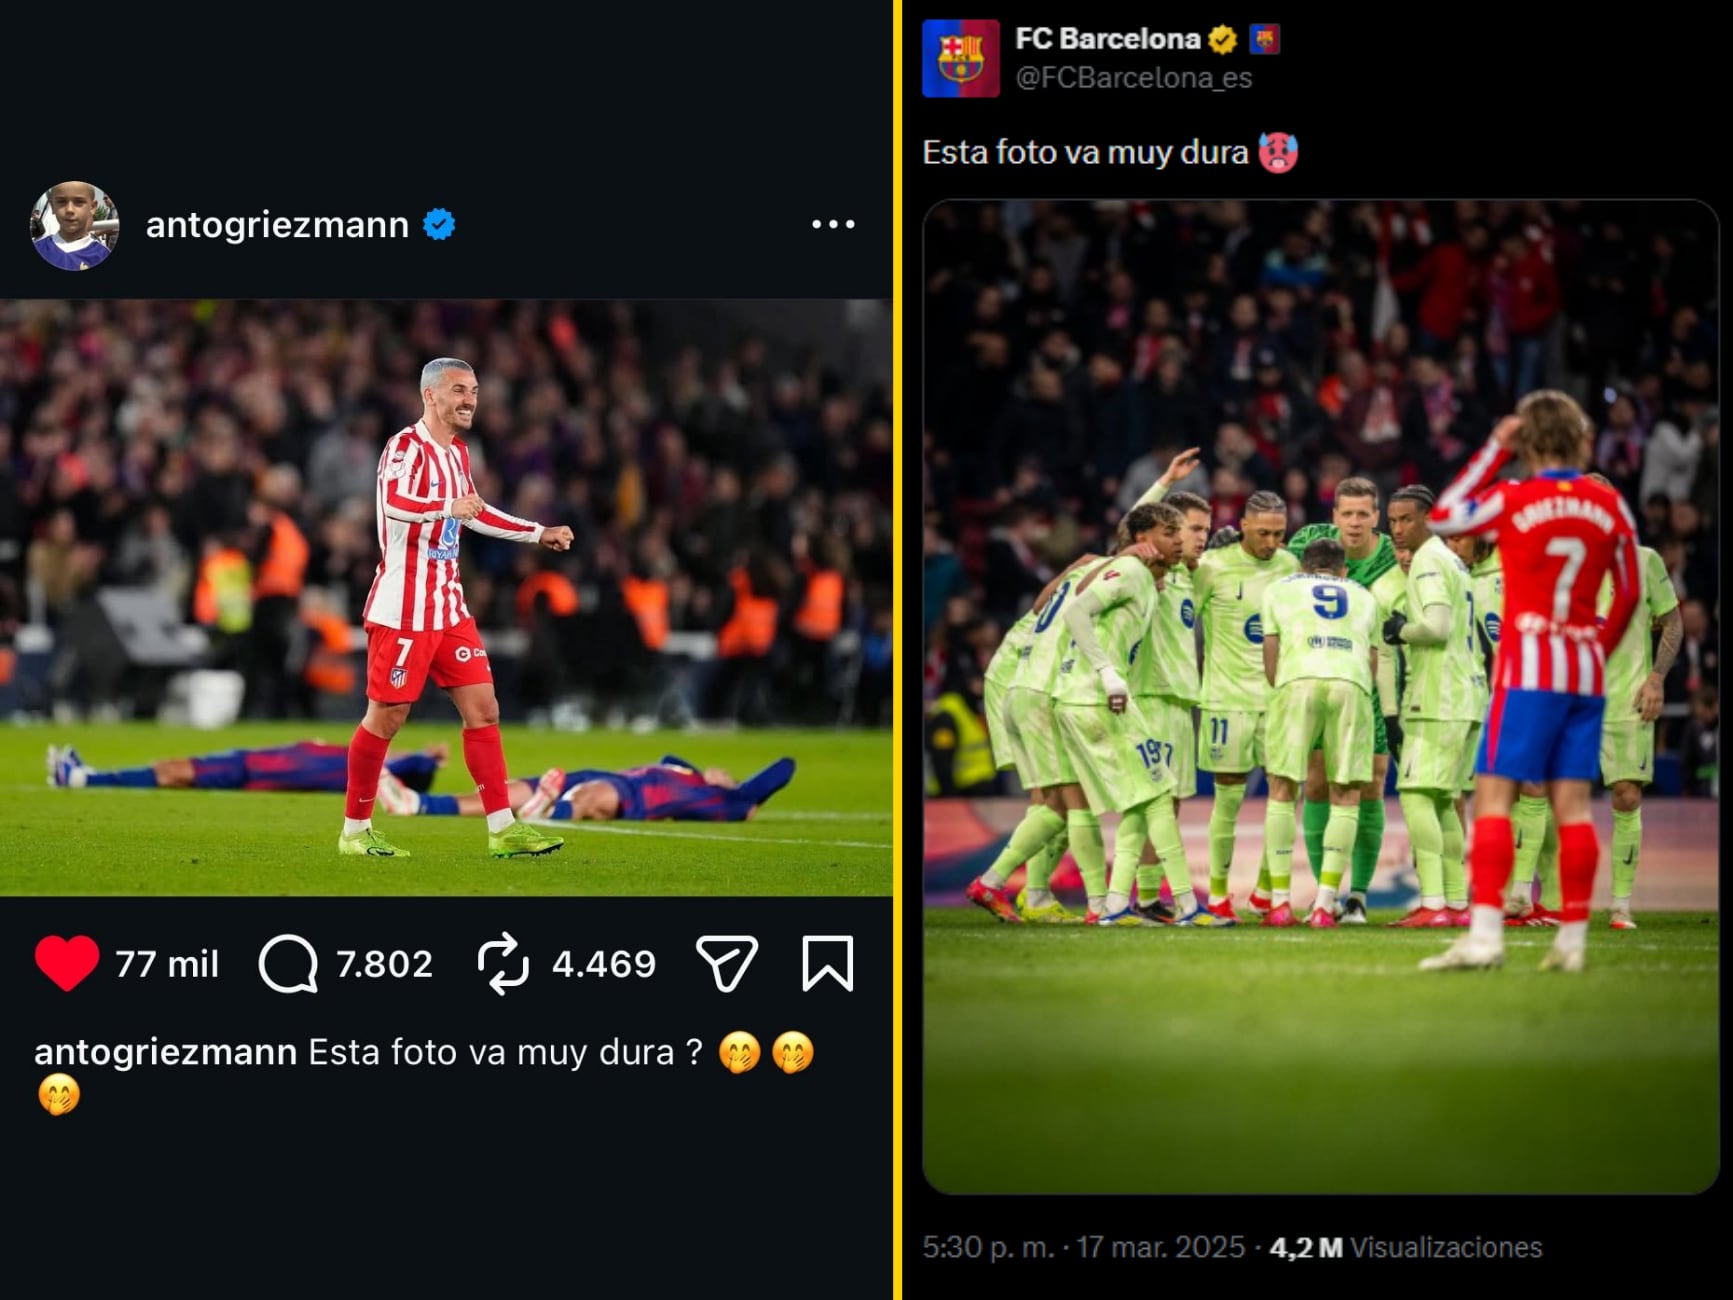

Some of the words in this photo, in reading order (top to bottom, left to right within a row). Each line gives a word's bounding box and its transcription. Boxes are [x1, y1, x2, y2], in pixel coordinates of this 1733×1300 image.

[1545, 537, 1587, 622] 7
[1312, 585, 1348, 620] 9
[396, 638, 414, 667] 7
[1211, 717, 1228, 746] 11
